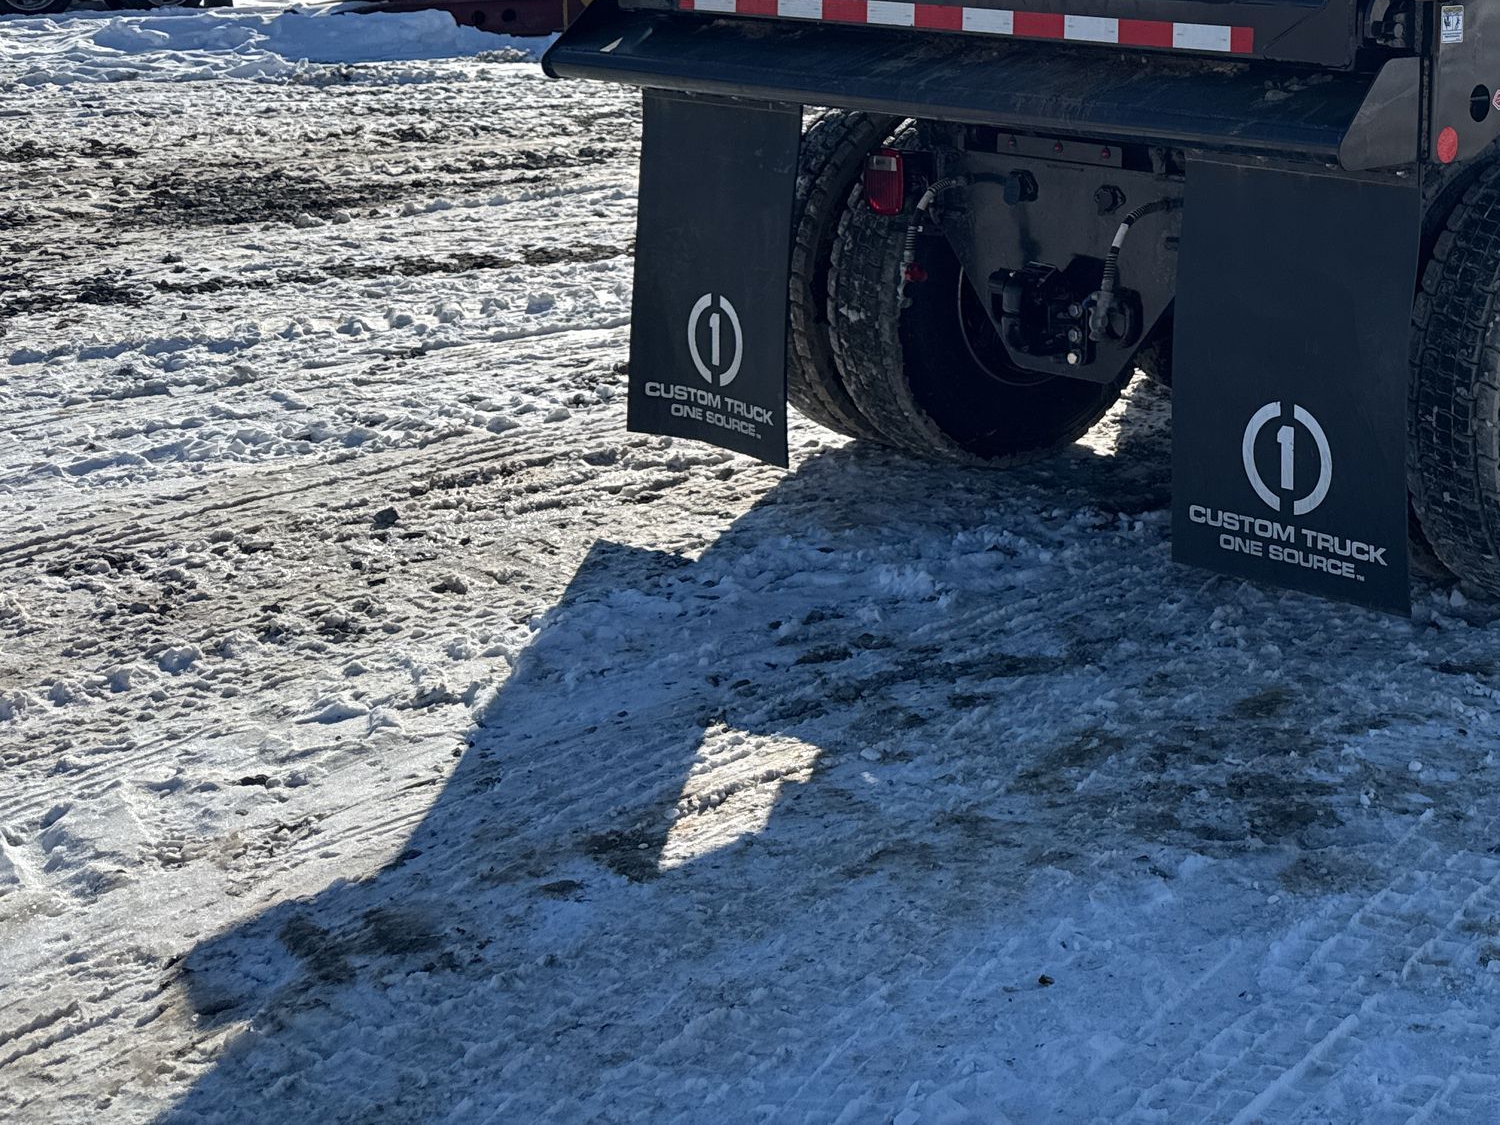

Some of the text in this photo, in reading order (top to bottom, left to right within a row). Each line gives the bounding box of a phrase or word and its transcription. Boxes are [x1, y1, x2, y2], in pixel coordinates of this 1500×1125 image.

[644, 381, 775, 426] CUSTOM TRUCK
[671, 403, 756, 438] ONE SOURCE
[1188, 504, 1388, 566] CUSTOM TRUCK
[1219, 534, 1263, 557] ONE
[1268, 545, 1355, 579] SOURCE
